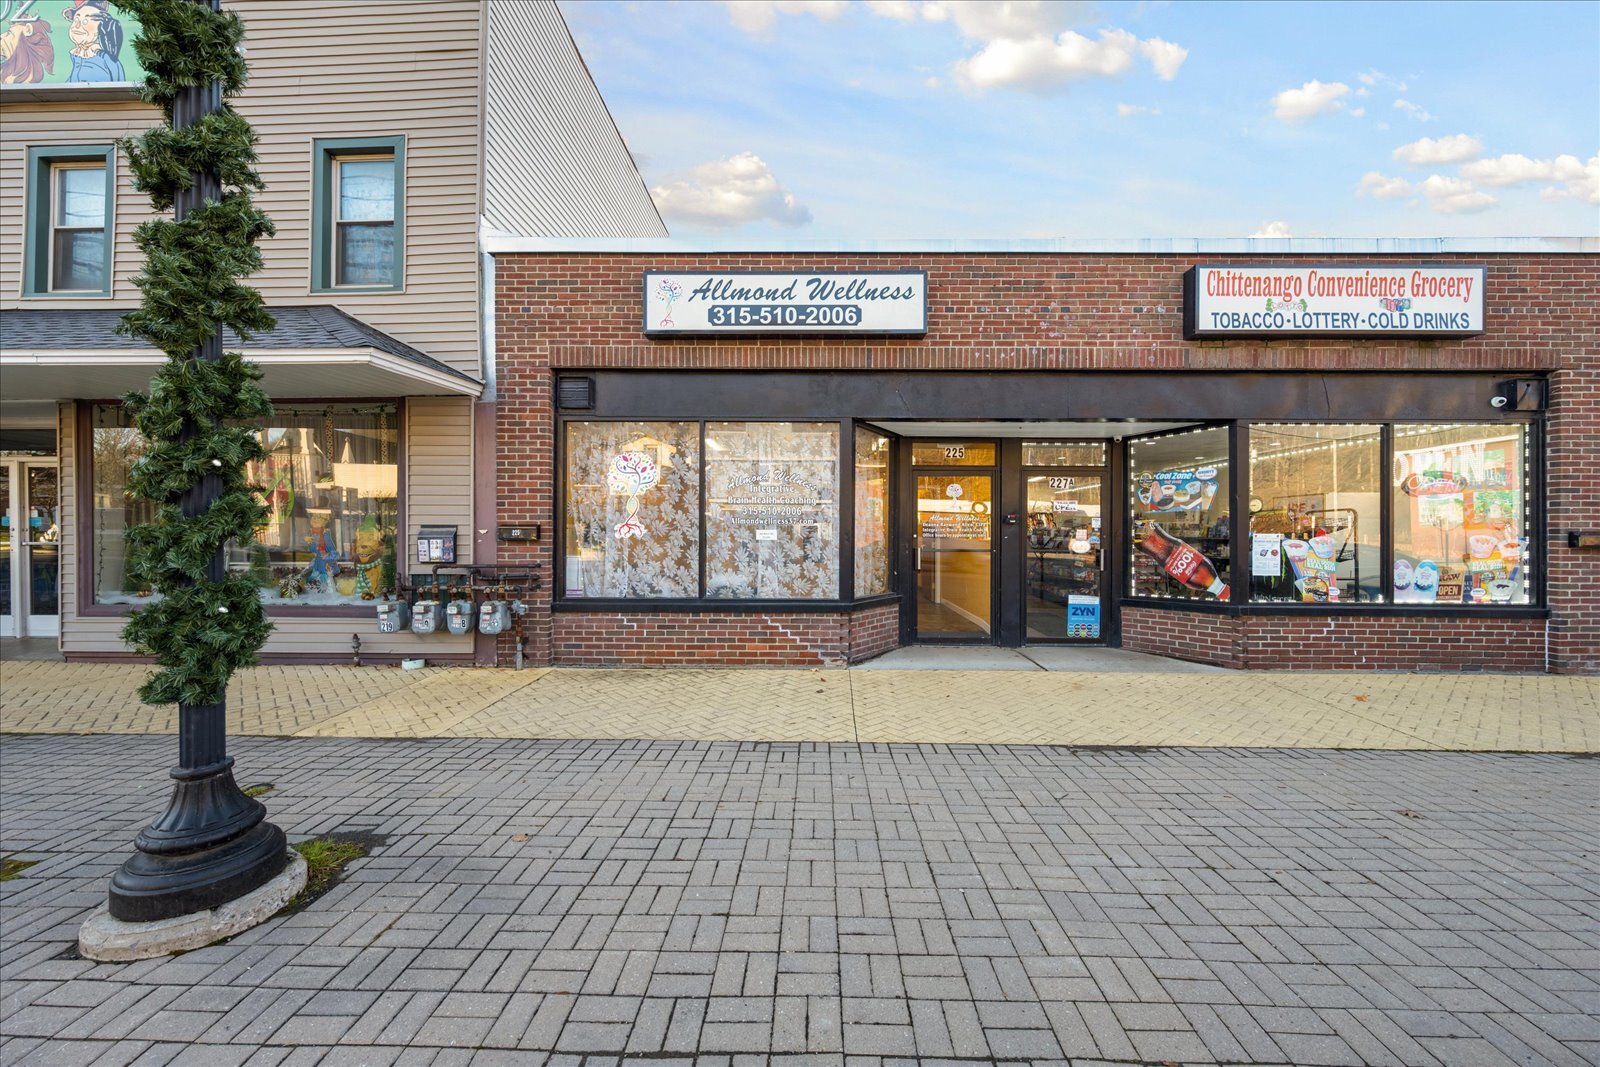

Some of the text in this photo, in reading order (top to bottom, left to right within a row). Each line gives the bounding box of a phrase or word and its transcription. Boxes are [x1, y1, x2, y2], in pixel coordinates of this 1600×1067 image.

[688, 277, 916, 302] Allmond Wellness
[1206, 270, 1473, 303] Chittenango Convenience Grocery
[713, 306, 858, 325] 315-510-2006
[1211, 312, 1470, 329] TOBACCO LOTTERY COLD DRINKS
[945, 447, 964, 458] 225
[727, 469, 817, 491] Allmond Wellness
[1155, 472, 1193, 480] Cool Zone
[749, 484, 795, 494] Integrative
[1050, 478, 1074, 489] 227A
[728, 496, 817, 506] Brain Health Coaching
[743, 507, 802, 516] 315-510-2006
[1170, 551, 1194, 576] 100%
[1438, 585, 1459, 595] OPEN
[1071, 606, 1095, 616] ZYN
